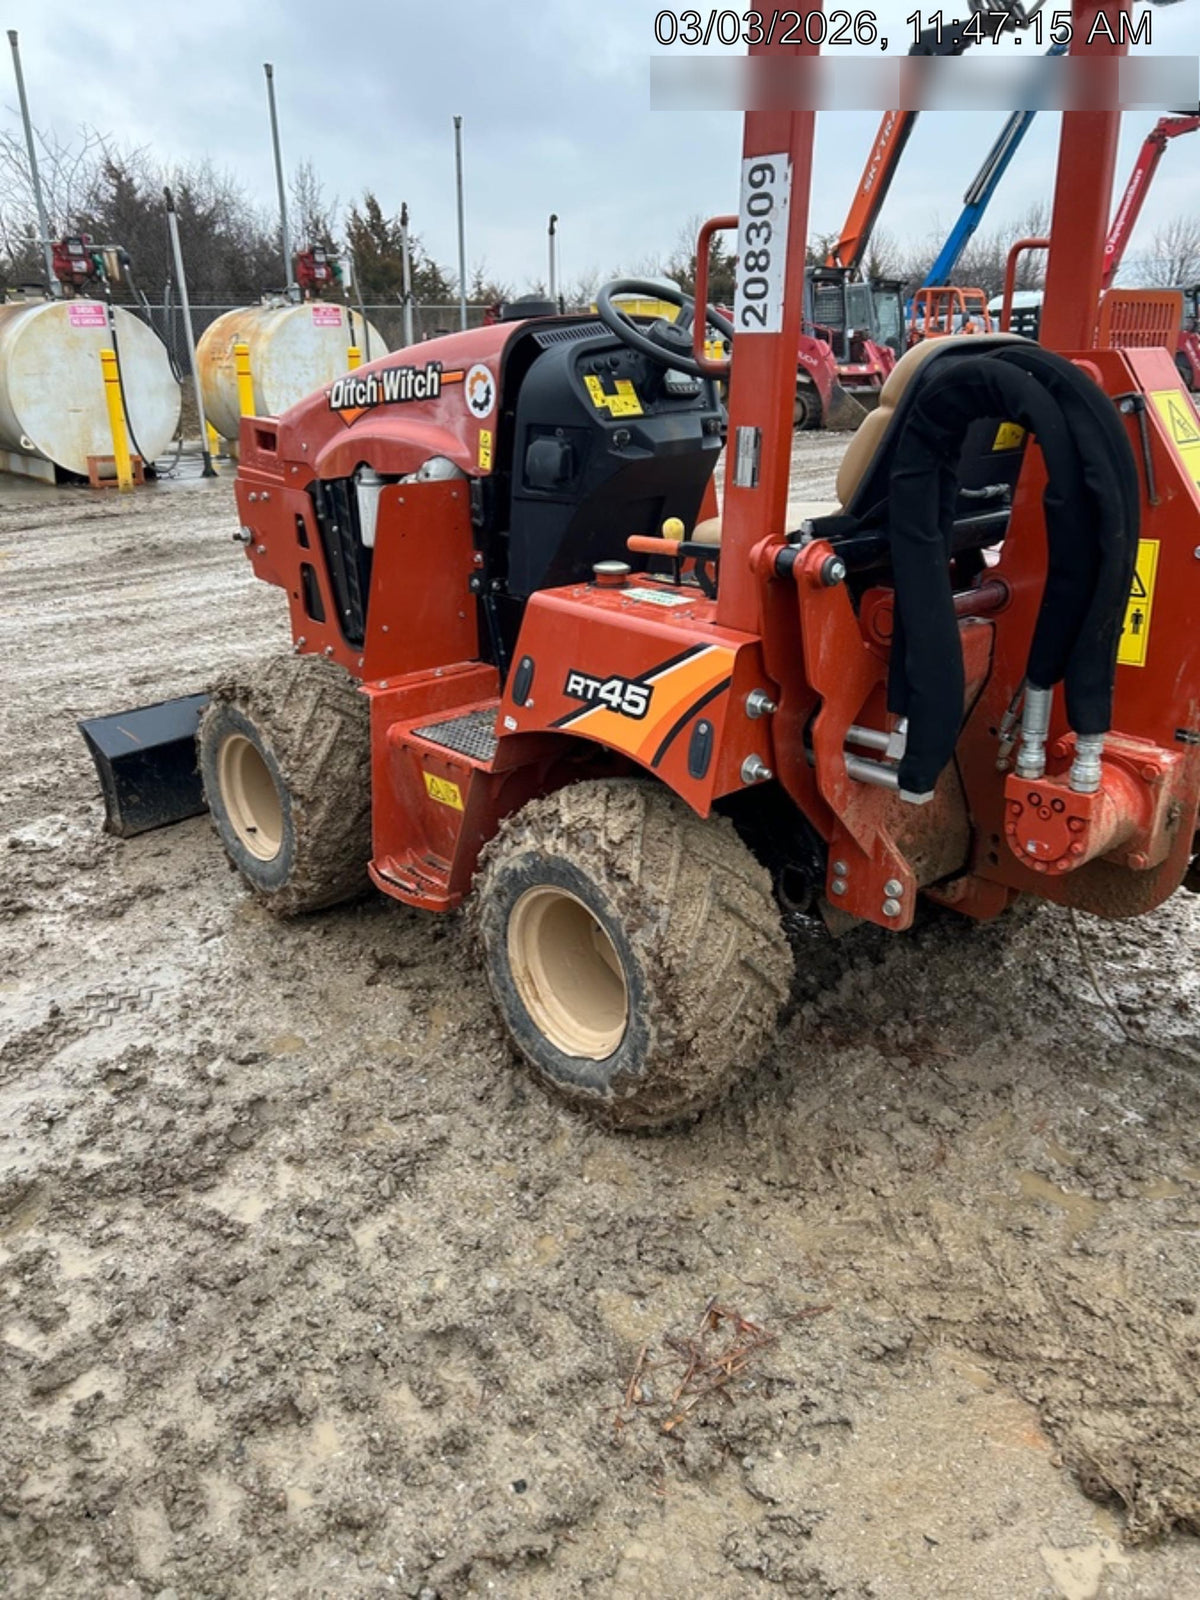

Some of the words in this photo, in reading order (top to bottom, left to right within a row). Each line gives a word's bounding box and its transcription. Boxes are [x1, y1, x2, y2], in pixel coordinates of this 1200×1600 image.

[741, 163, 776, 328] 208309
[330, 374, 377, 409] Ditch
[382, 363, 439, 401] Witch
[566, 673, 650, 716] RT45
